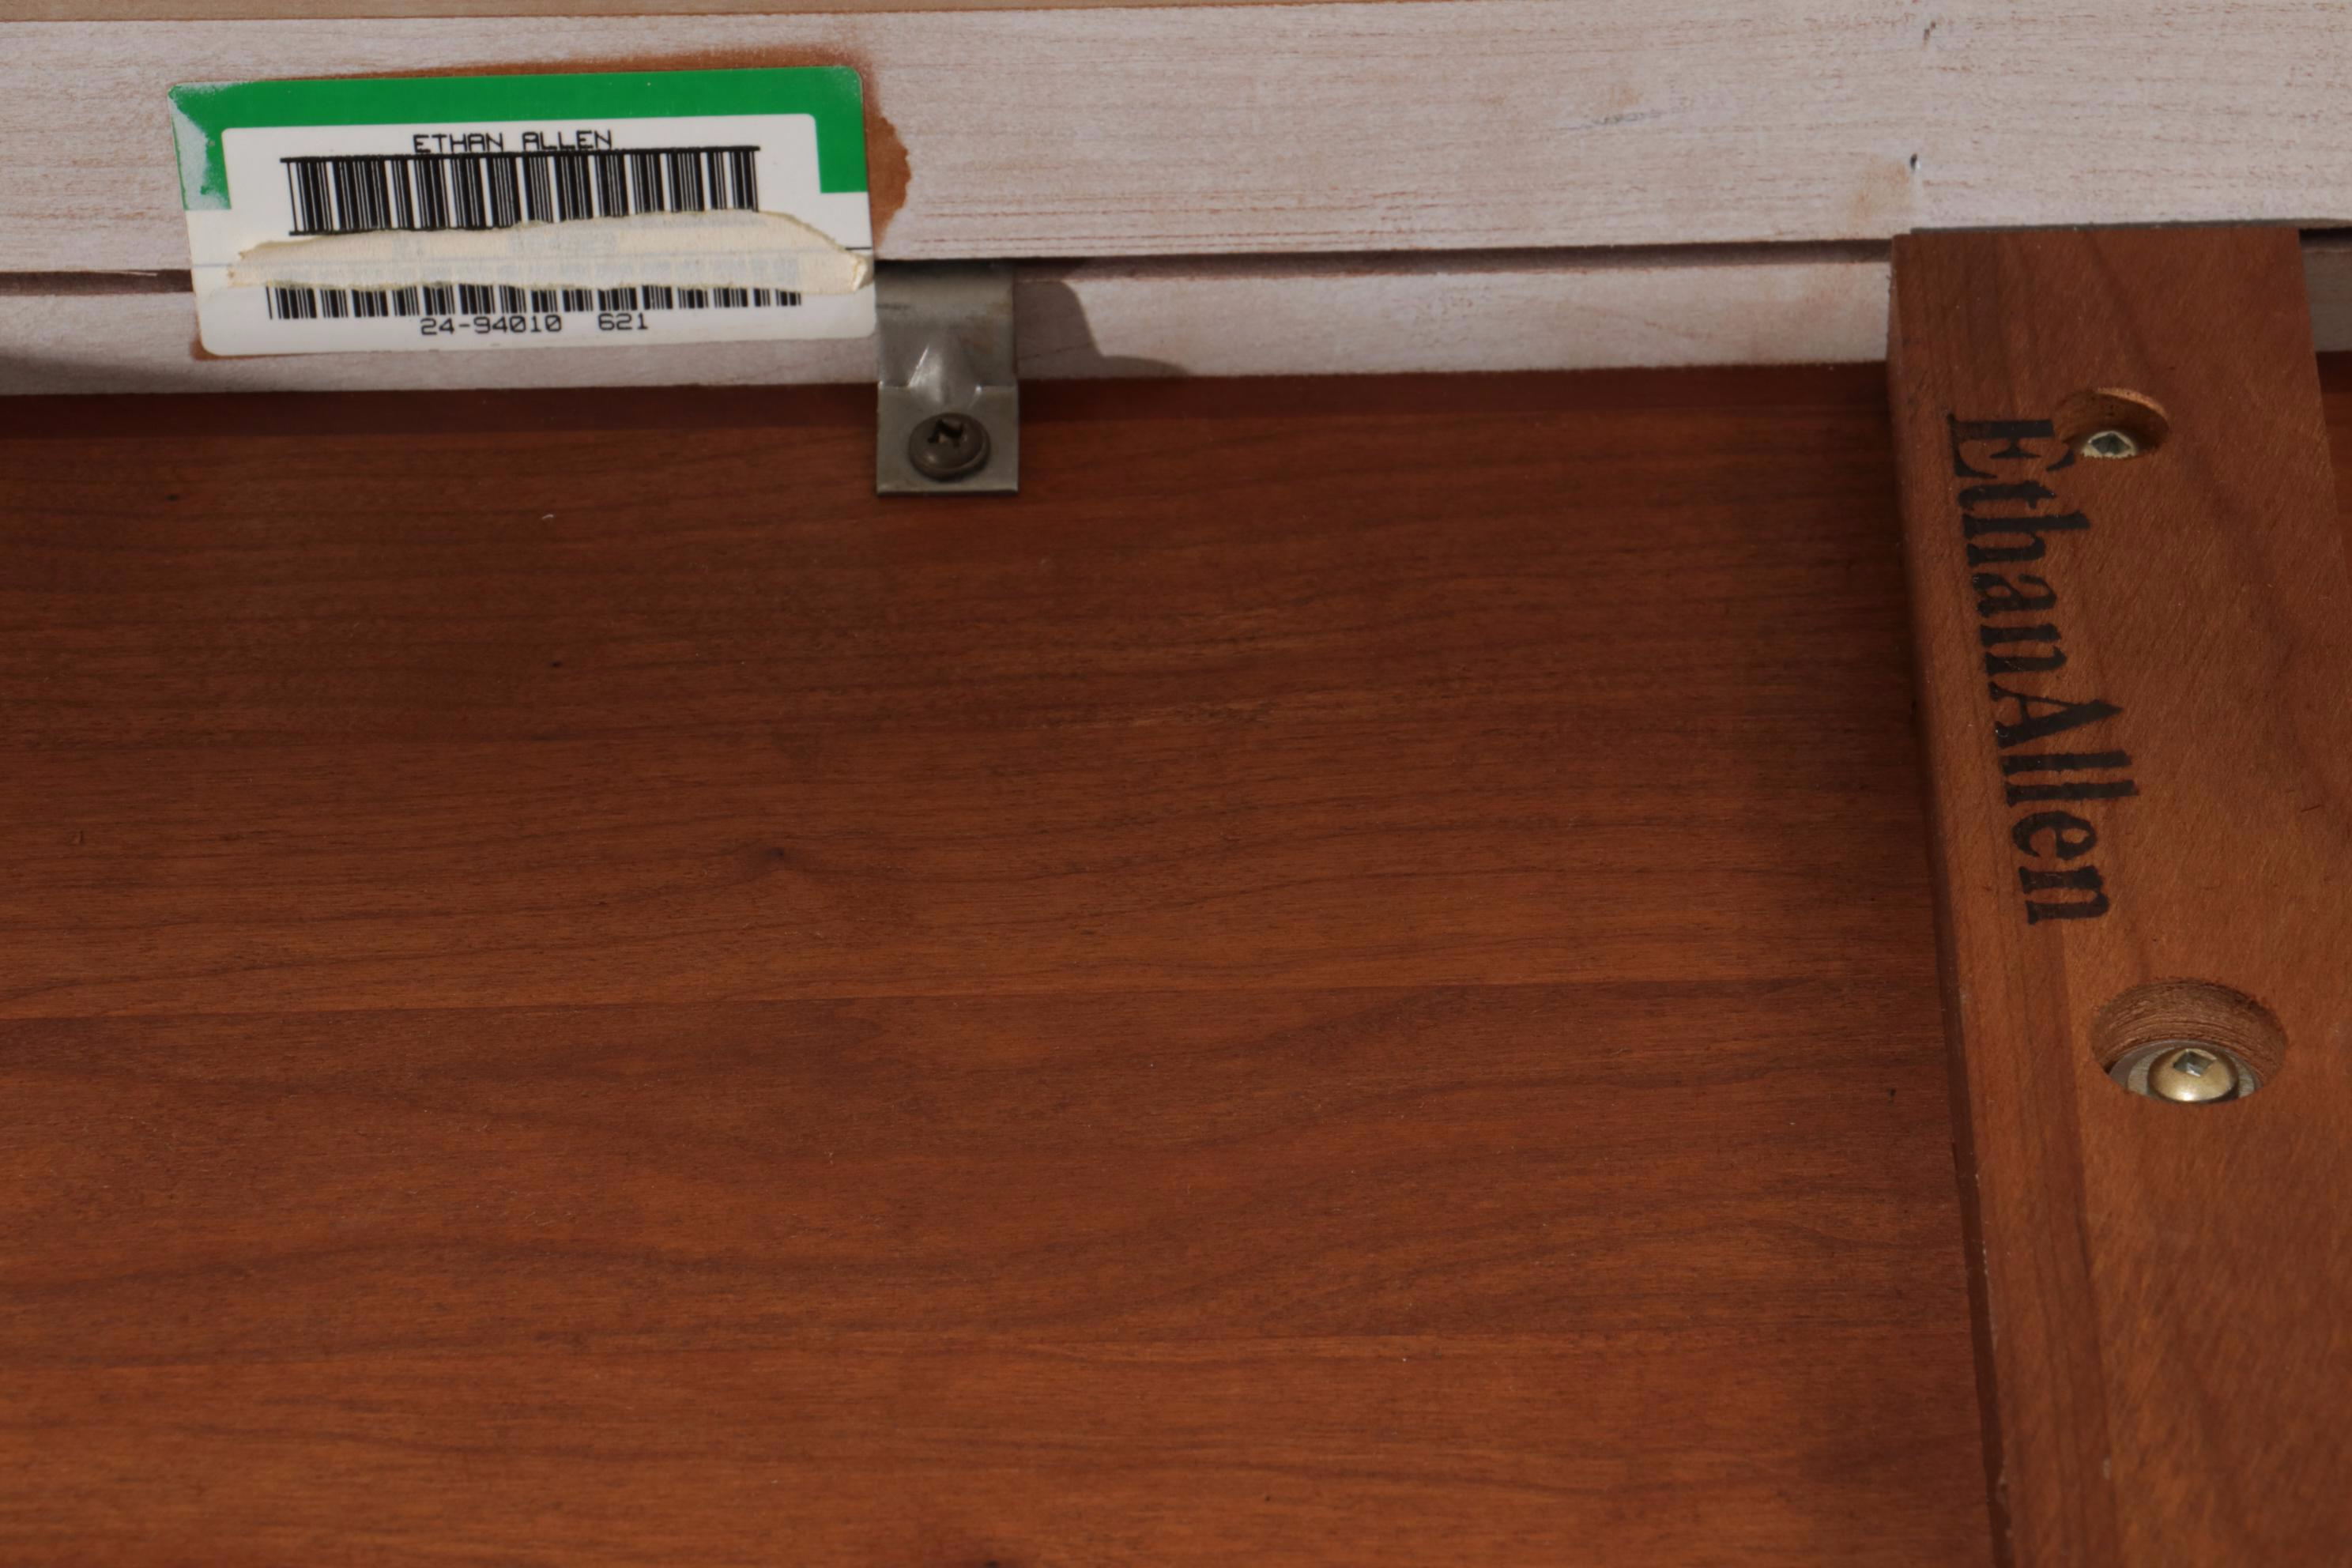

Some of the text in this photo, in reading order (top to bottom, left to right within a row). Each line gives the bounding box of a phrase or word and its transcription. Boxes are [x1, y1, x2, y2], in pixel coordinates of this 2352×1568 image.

[413, 129, 612, 154] ETHAN ALLEN
[420, 311, 649, 336] 24-94010 621
